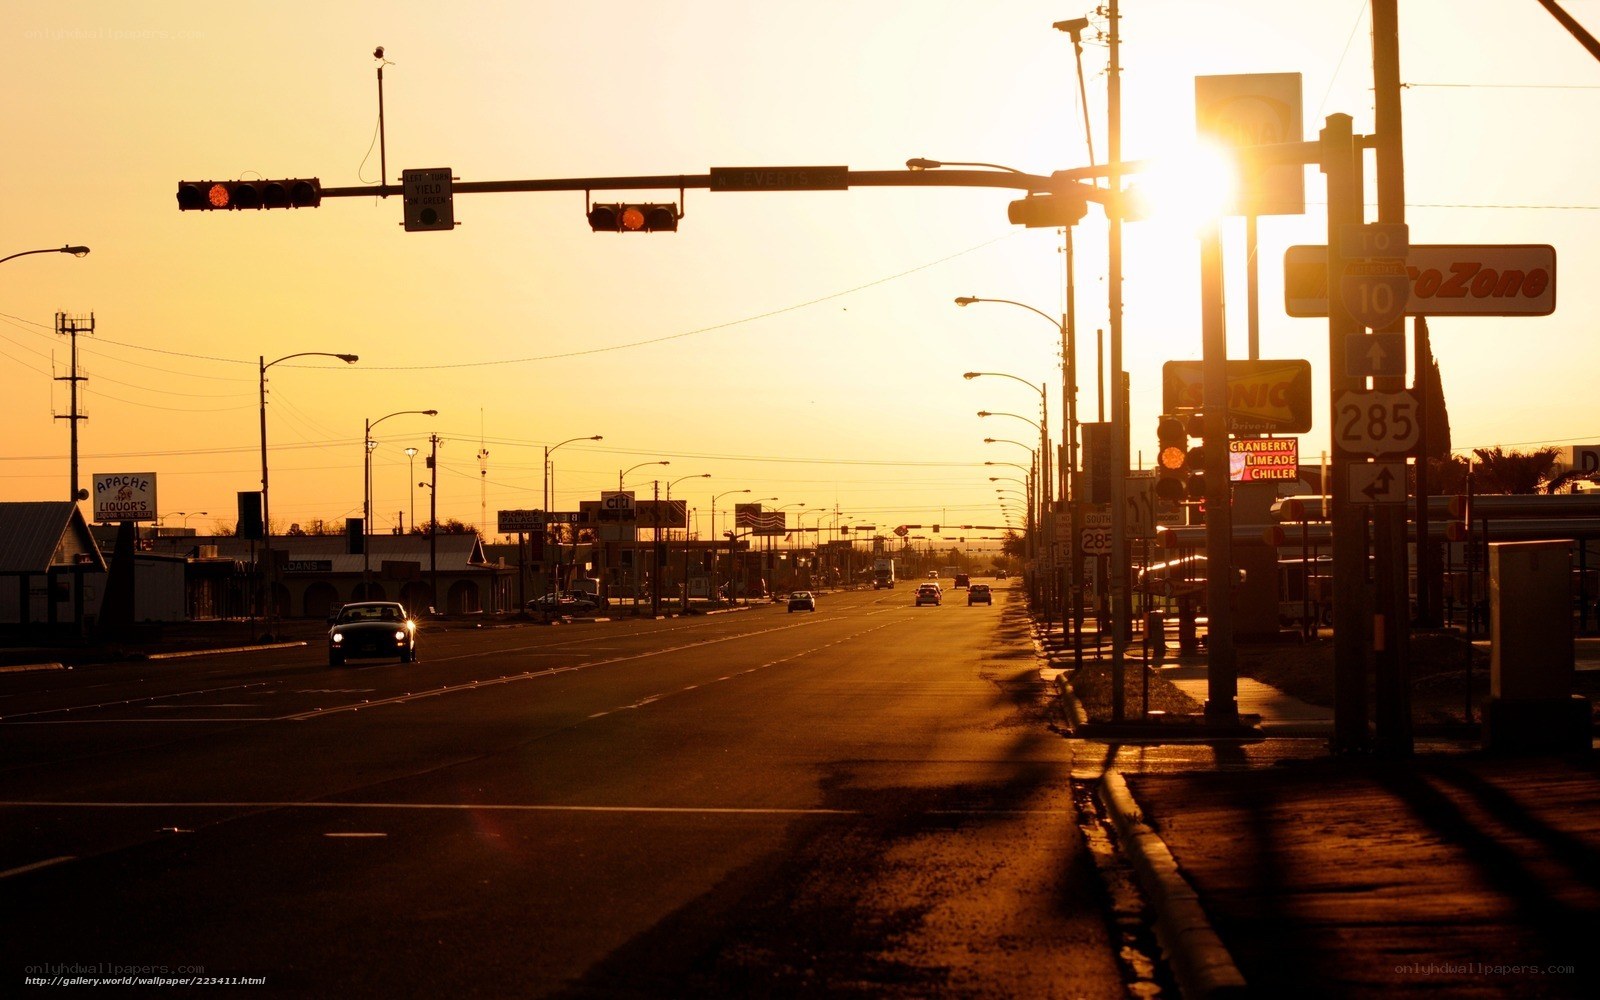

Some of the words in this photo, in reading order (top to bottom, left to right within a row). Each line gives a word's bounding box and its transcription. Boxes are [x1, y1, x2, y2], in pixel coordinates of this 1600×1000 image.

[406, 174, 423, 183] LEFT
[431, 173, 449, 181] TURN
[743, 172, 809, 187] EVERTS
[415, 184, 441, 195] YIELD
[408, 197, 419, 206] ON
[423, 196, 446, 206] GREEN
[1361, 231, 1390, 251] TO
[1358, 282, 1394, 315] 10
[1186, 381, 1291, 408] SNIC
[1341, 403, 1412, 442] 285
[1229, 440, 1295, 452] CRANBERRY
[1246, 455, 1296, 466] LIMEADE
[1251, 468, 1296, 479] CHILLER
[97, 476, 149, 493] APACHE
[100, 500, 147, 512] LIQUOR'S
[1086, 514, 1111, 524] SOUTH
[1083, 533, 1112, 549] 285
